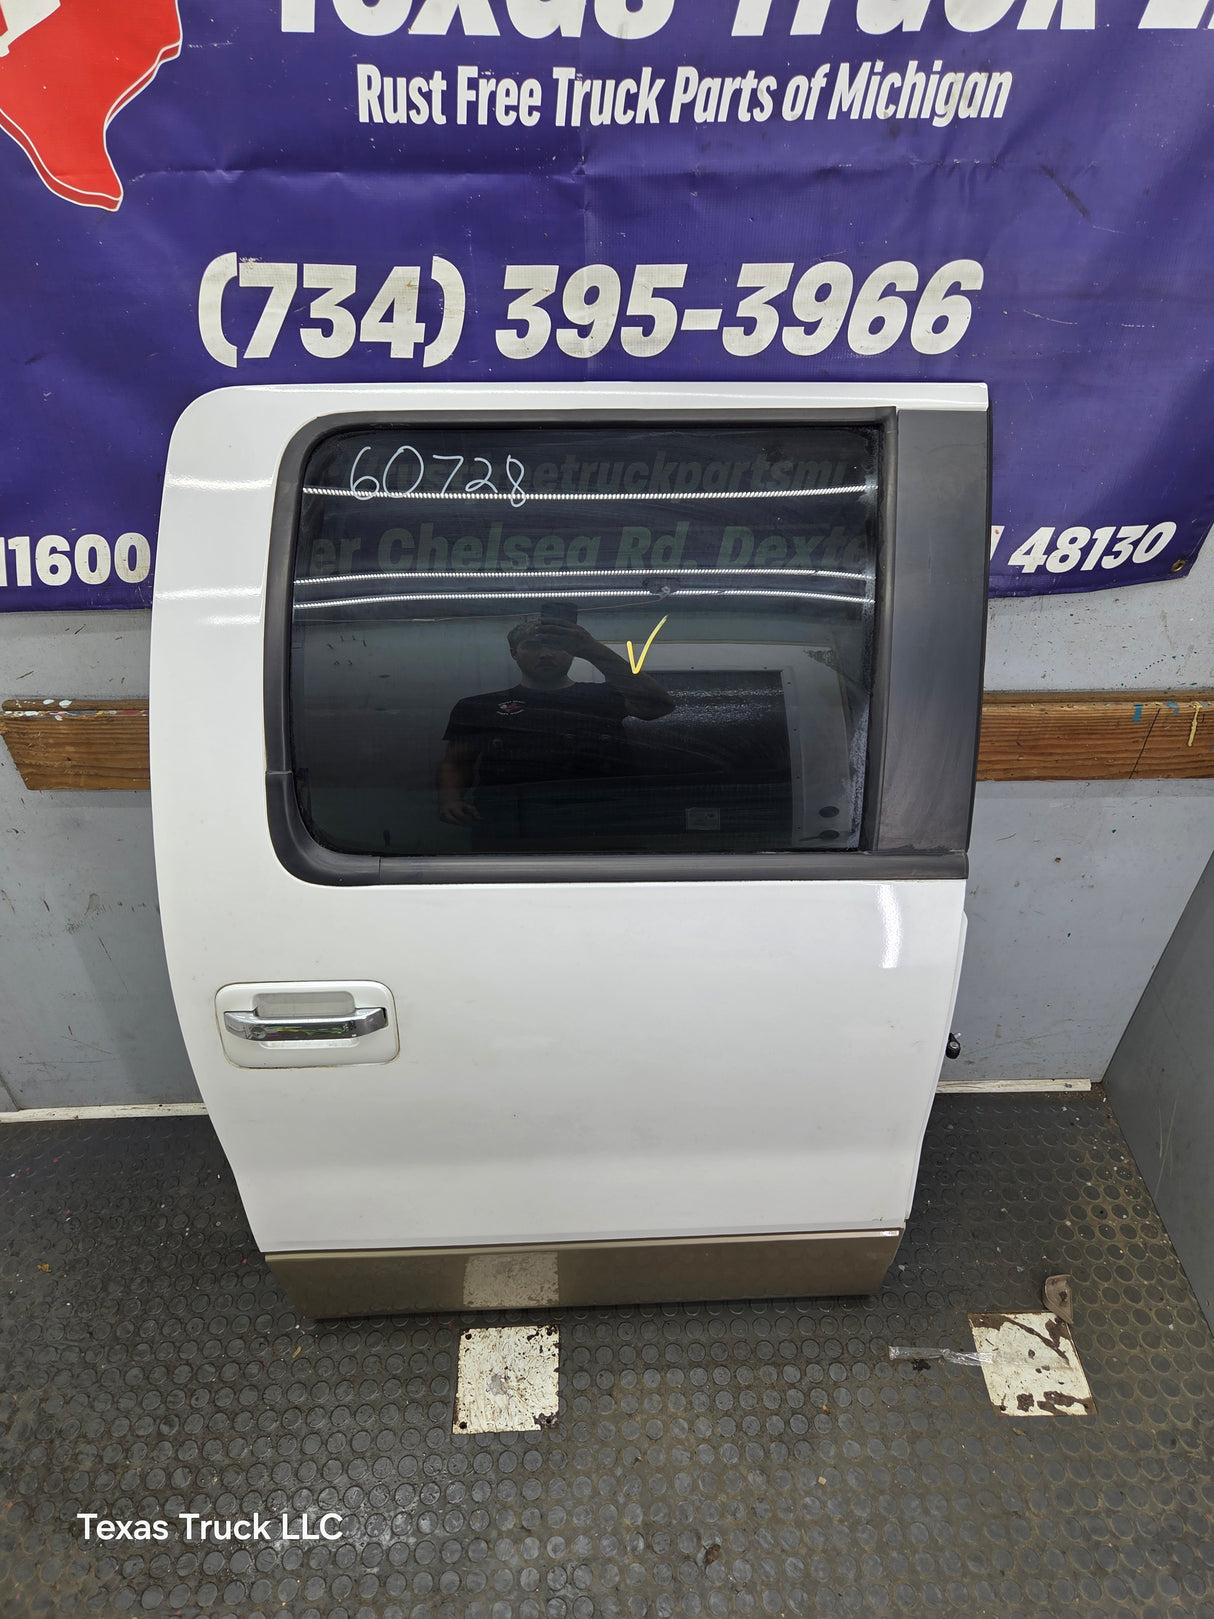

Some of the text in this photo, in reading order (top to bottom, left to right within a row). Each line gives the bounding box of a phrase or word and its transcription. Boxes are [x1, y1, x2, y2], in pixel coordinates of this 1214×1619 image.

[356, 59, 1013, 128] Rust Free Truck Parts of Michigan
[199, 252, 984, 368] (734) 395-3966
[351, 445, 527, 508] 60728
[377, 521, 601, 572] Chelsea
[615, 520, 698, 570] Rd.
[714, 524, 868, 571] Dexte
[1007, 521, 1177, 574] 48130
